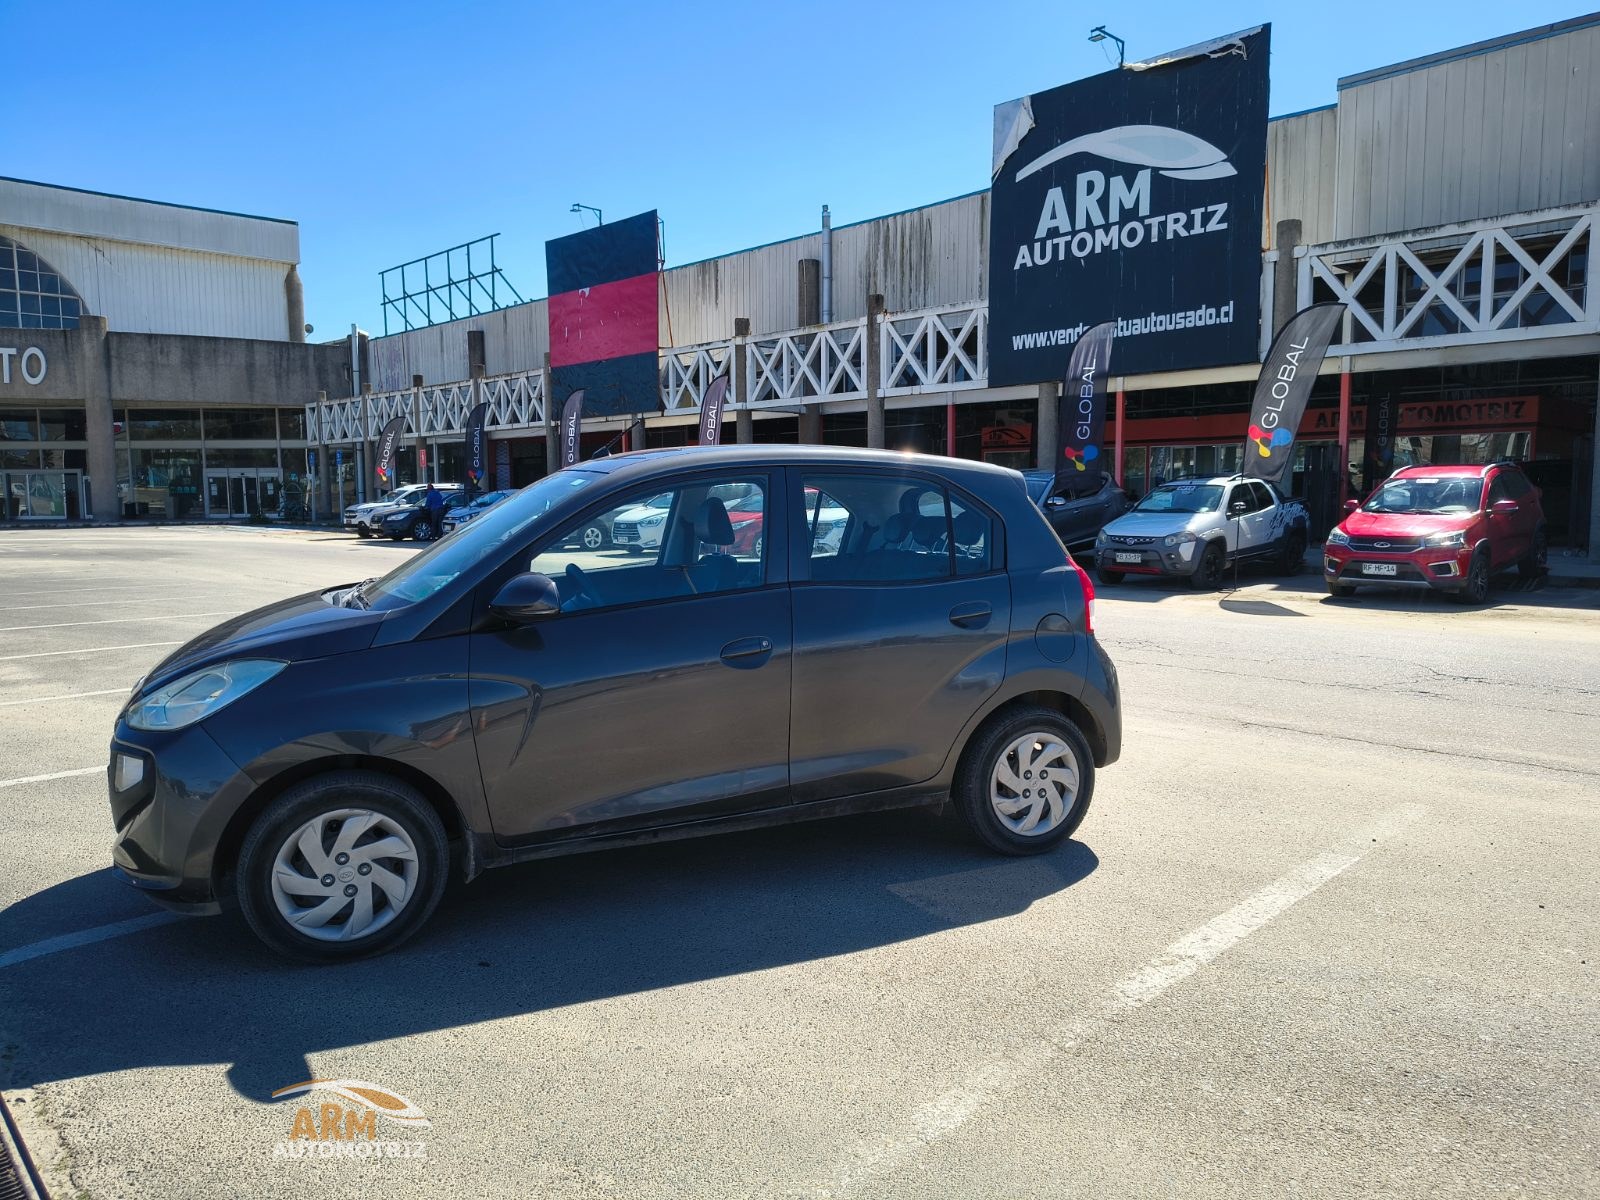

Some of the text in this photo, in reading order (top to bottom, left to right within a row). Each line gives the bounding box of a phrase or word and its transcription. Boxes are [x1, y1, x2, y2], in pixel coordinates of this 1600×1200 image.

[1034, 168, 1152, 239] ARM
[1013, 202, 1228, 271] AUTOMOTRIZ
[1076, 357, 1097, 441] GLOBAL
[1261, 335, 1309, 430] GLOBAL
[473, 423, 482, 468] GLOBAL
[567, 411, 577, 464] GLOBAL
[706, 400, 718, 446] OBAL
[1377, 391, 1391, 447] GLOBAL
[381, 430, 396, 470] GLOBAL
